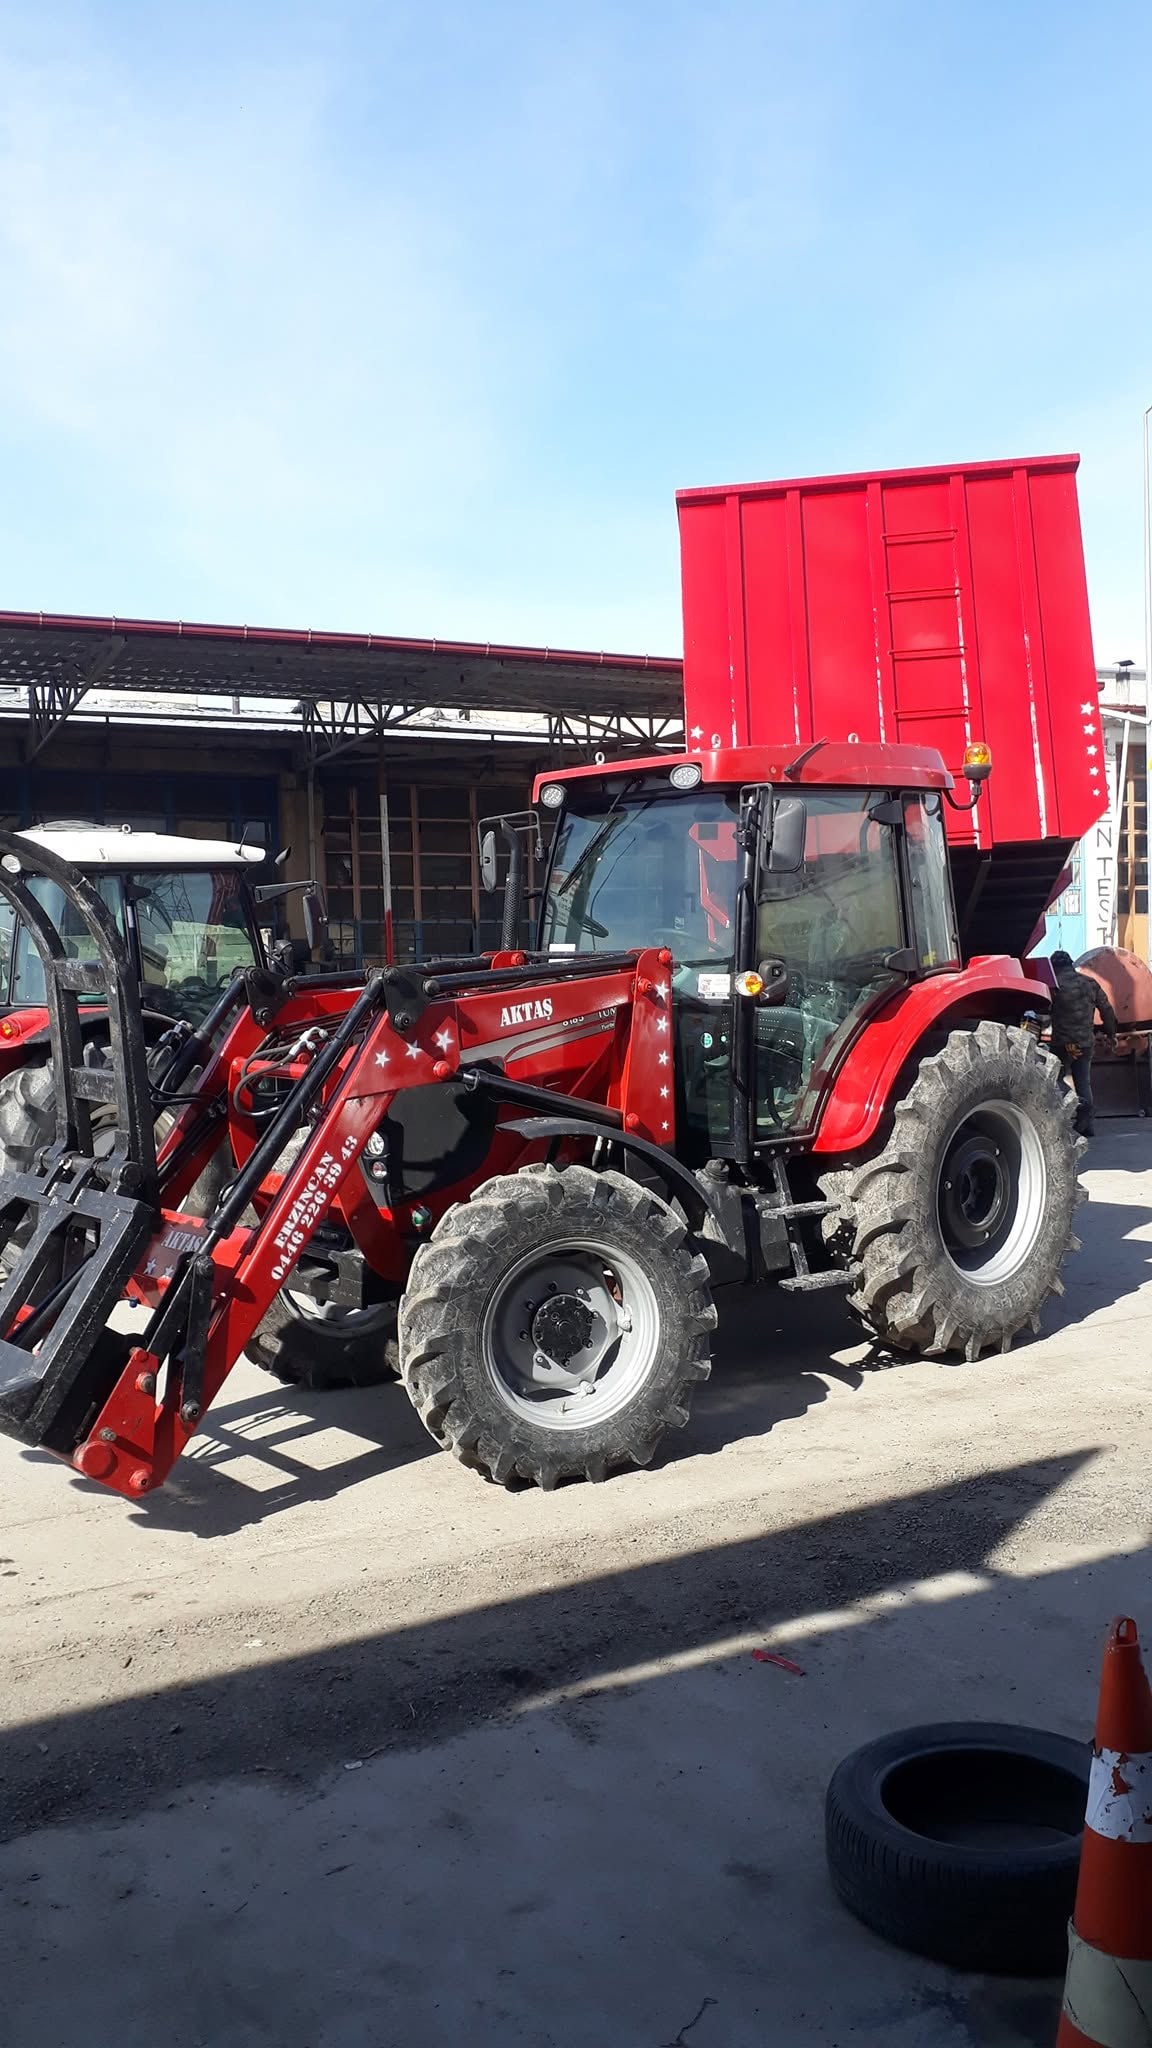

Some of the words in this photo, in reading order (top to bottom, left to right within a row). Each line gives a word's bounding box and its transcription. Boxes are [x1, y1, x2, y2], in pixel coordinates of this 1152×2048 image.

[501, 998, 553, 1027] AKTAŞ
[271, 1231, 305, 1281] 0446
[301, 1190, 327, 1229] 226
[323, 1162, 343, 1188] 39
[341, 1135, 359, 1161] 43
[273, 1151, 334, 1249] ERZİNCAN
